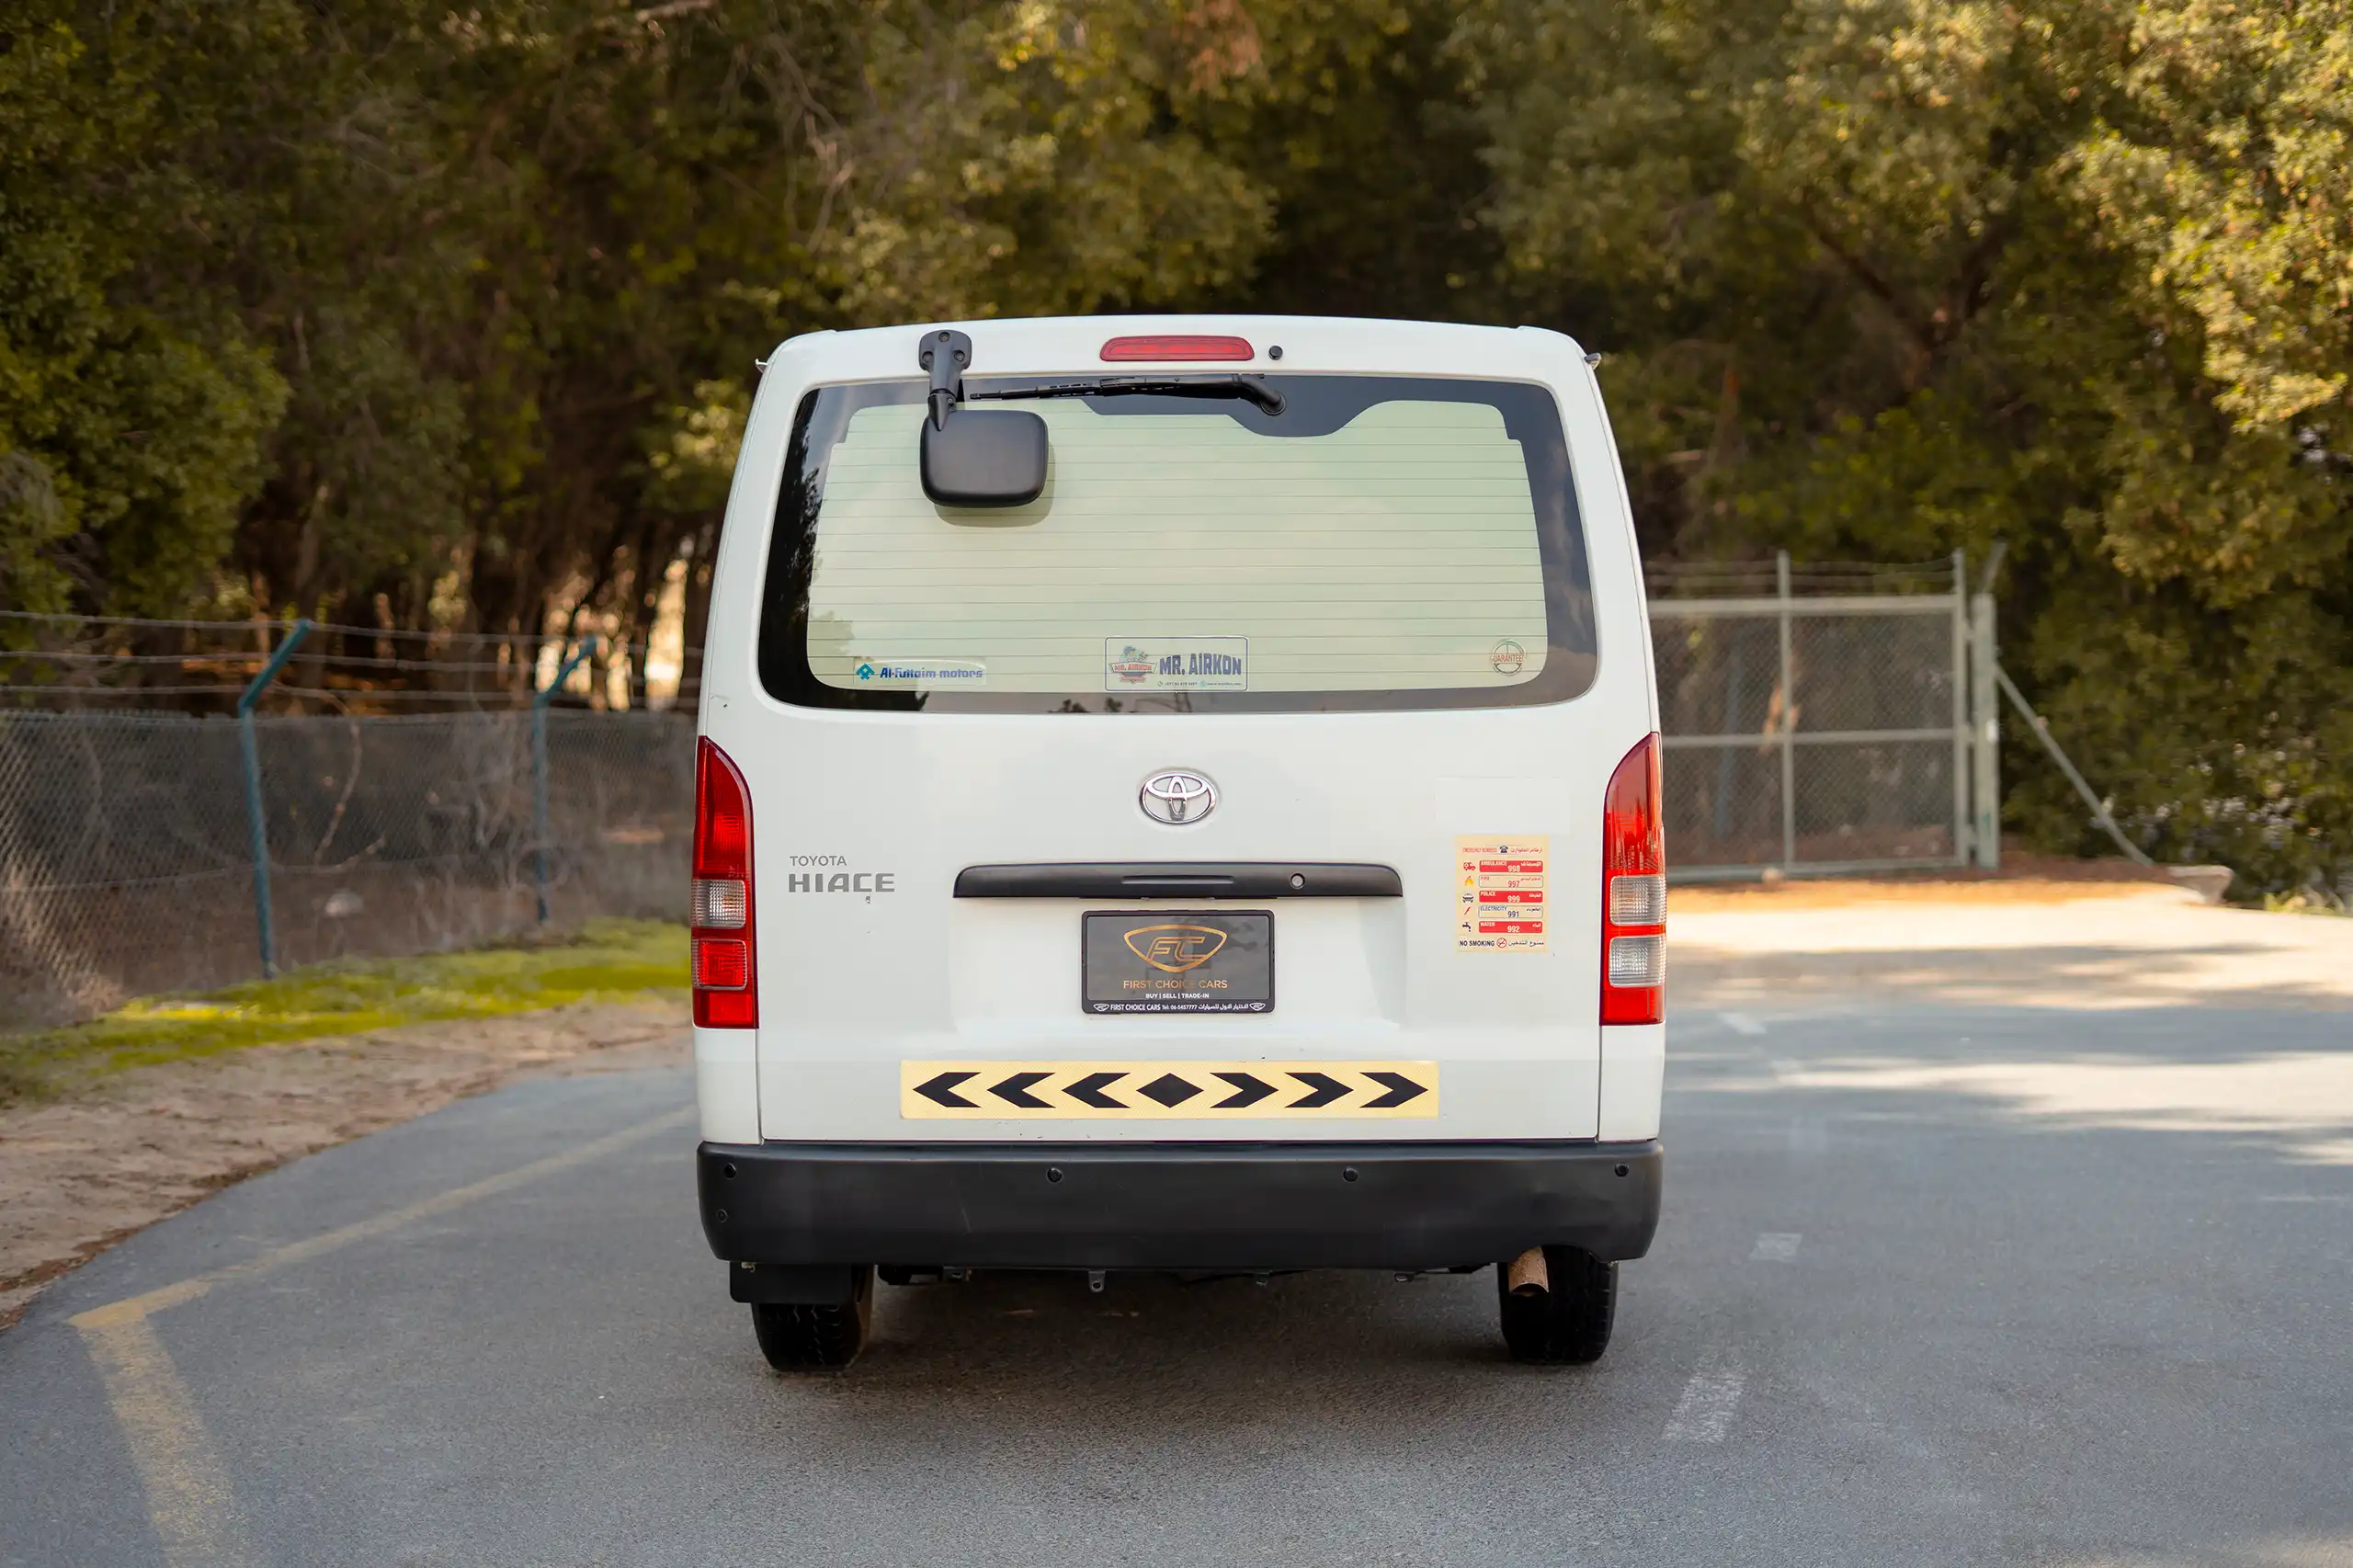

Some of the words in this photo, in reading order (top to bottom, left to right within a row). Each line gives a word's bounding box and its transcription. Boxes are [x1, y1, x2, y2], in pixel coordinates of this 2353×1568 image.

[1159, 653, 1186, 676] MR.
[939, 668, 983, 678] motors
[790, 856, 847, 867] TOYOTA
[789, 873, 895, 892] HIACE
[1123, 980, 1153, 989] FIRST
[1155, 980, 1196, 989] CHOICE
[1199, 980, 1228, 989] CARS
